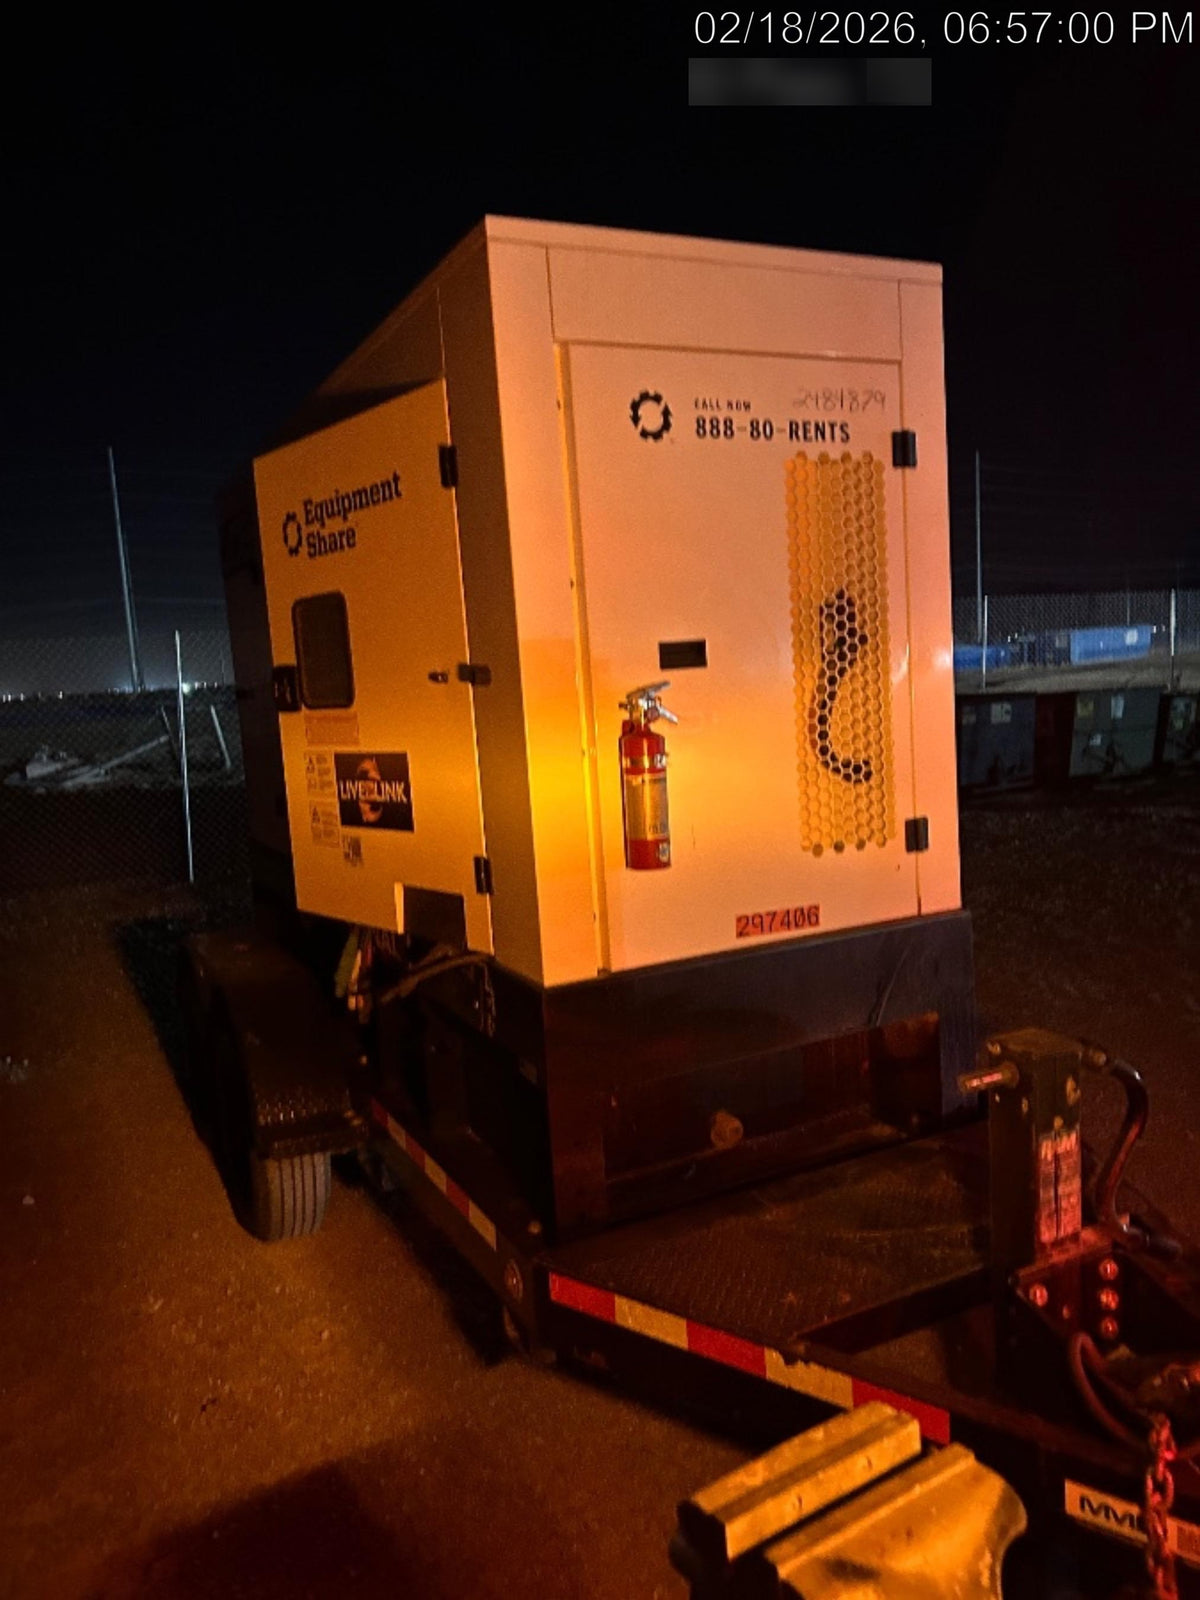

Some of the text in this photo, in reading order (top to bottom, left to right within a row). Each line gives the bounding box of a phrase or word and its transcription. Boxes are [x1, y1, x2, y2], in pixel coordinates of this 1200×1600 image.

[694, 398, 751, 412] CALL NOW
[695, 416, 850, 443] 888-80-RENTS
[303, 470, 402, 528] Equipment
[306, 526, 356, 560] Share
[736, 904, 820, 938] 297406
